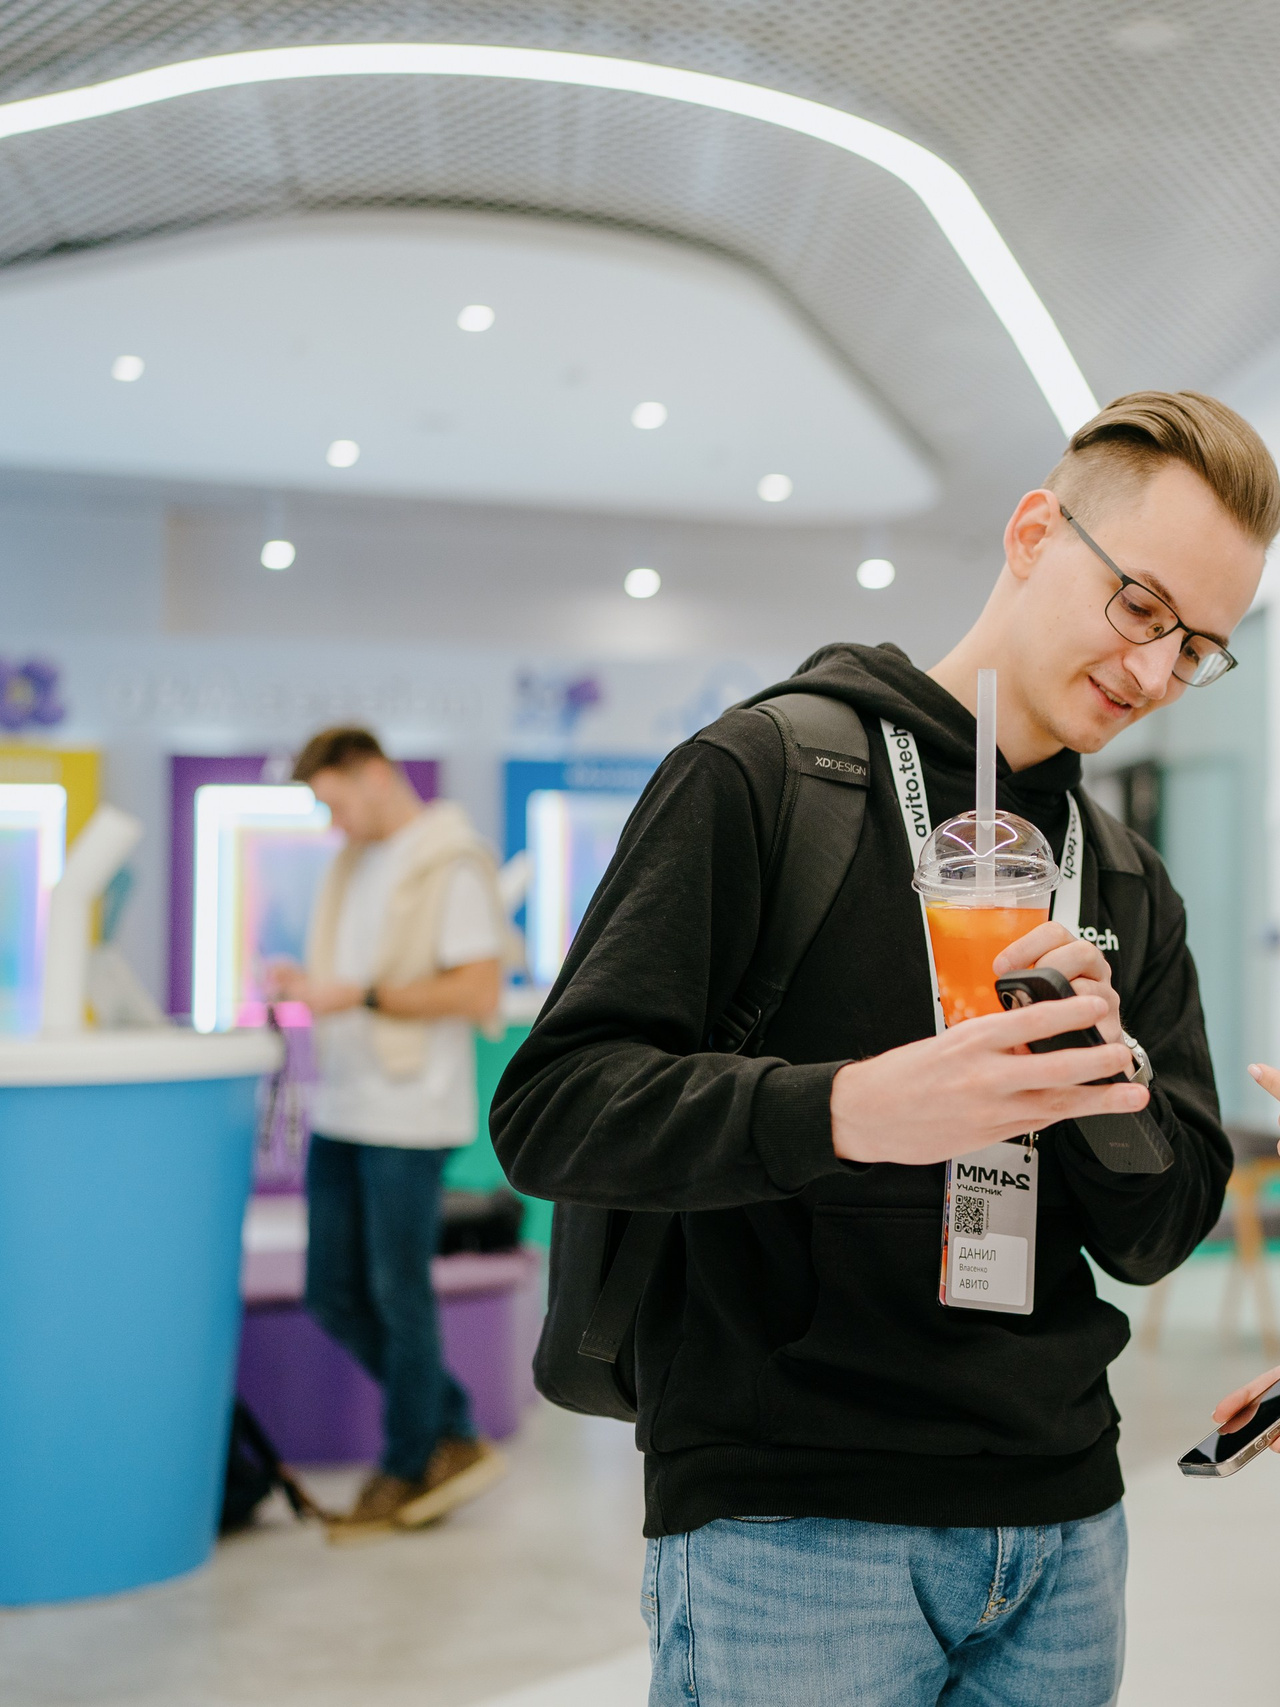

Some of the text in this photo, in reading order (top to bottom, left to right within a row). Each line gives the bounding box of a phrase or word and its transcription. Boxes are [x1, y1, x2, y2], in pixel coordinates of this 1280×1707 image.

[890, 726, 927, 838] avito.tech
[956, 1183, 1003, 1197] УЧАСТНИК
[959, 1246, 997, 1261] ДАНИЛ
[959, 1278, 990, 1291] АВИТО
